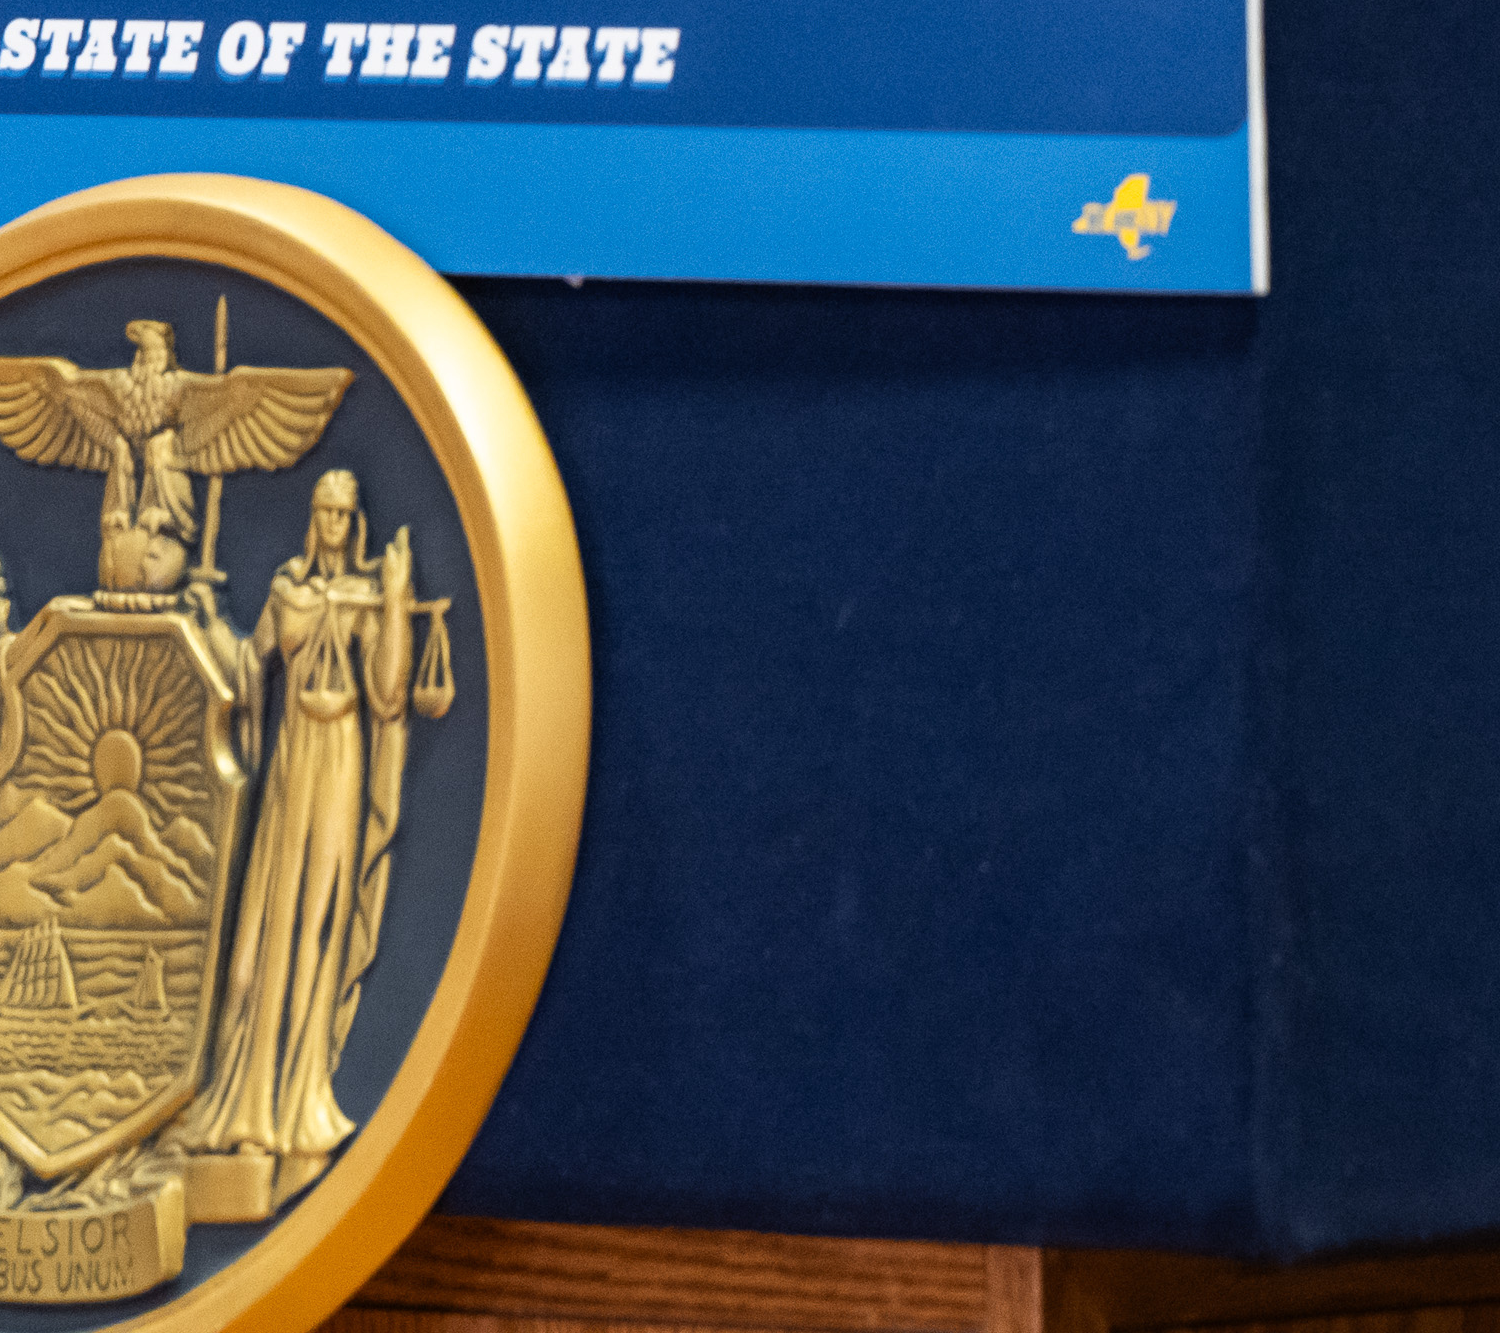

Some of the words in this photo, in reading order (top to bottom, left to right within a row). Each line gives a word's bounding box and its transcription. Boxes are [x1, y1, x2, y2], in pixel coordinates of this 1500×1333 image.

[217, 21, 306, 77] OF
[322, 23, 457, 79] THE
[466, 26, 682, 83] STATE
